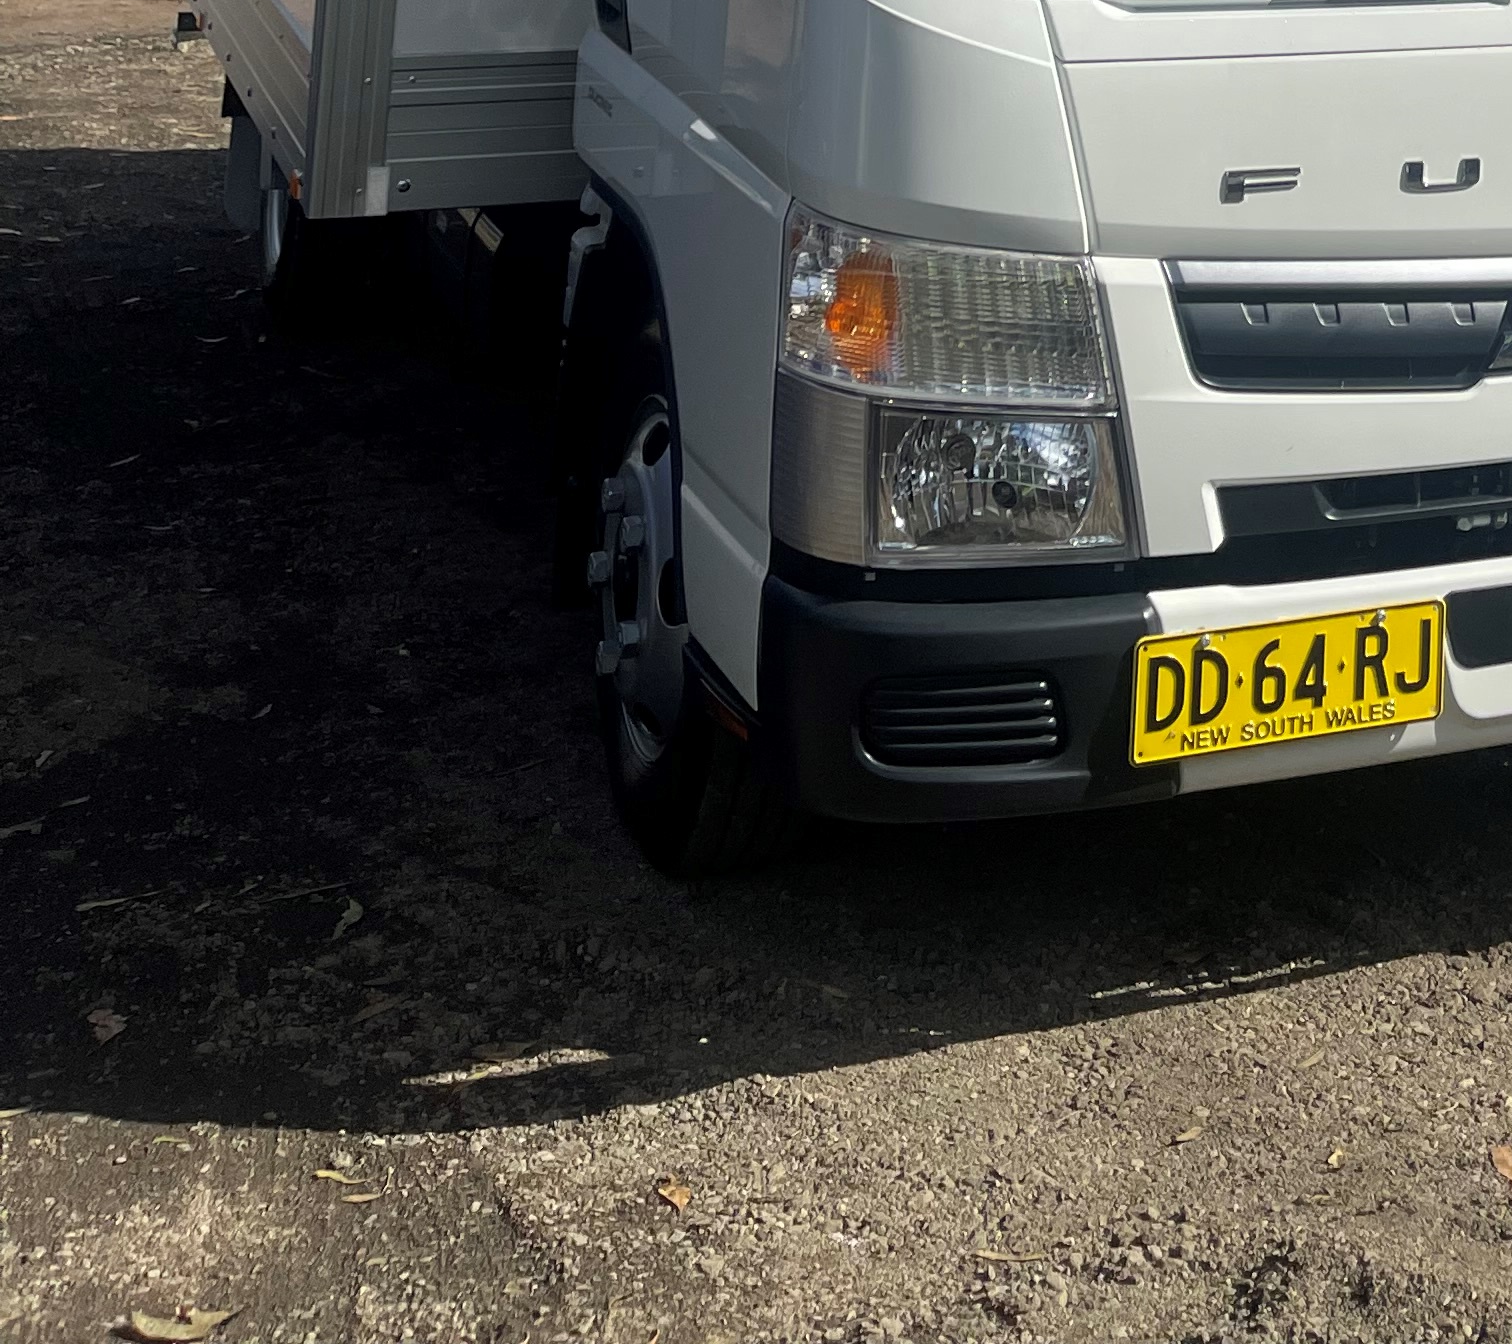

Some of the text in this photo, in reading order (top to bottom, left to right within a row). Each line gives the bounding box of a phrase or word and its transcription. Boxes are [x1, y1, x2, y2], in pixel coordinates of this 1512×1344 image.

[1180, 699, 1396, 752] NEW SOUTH WALES
